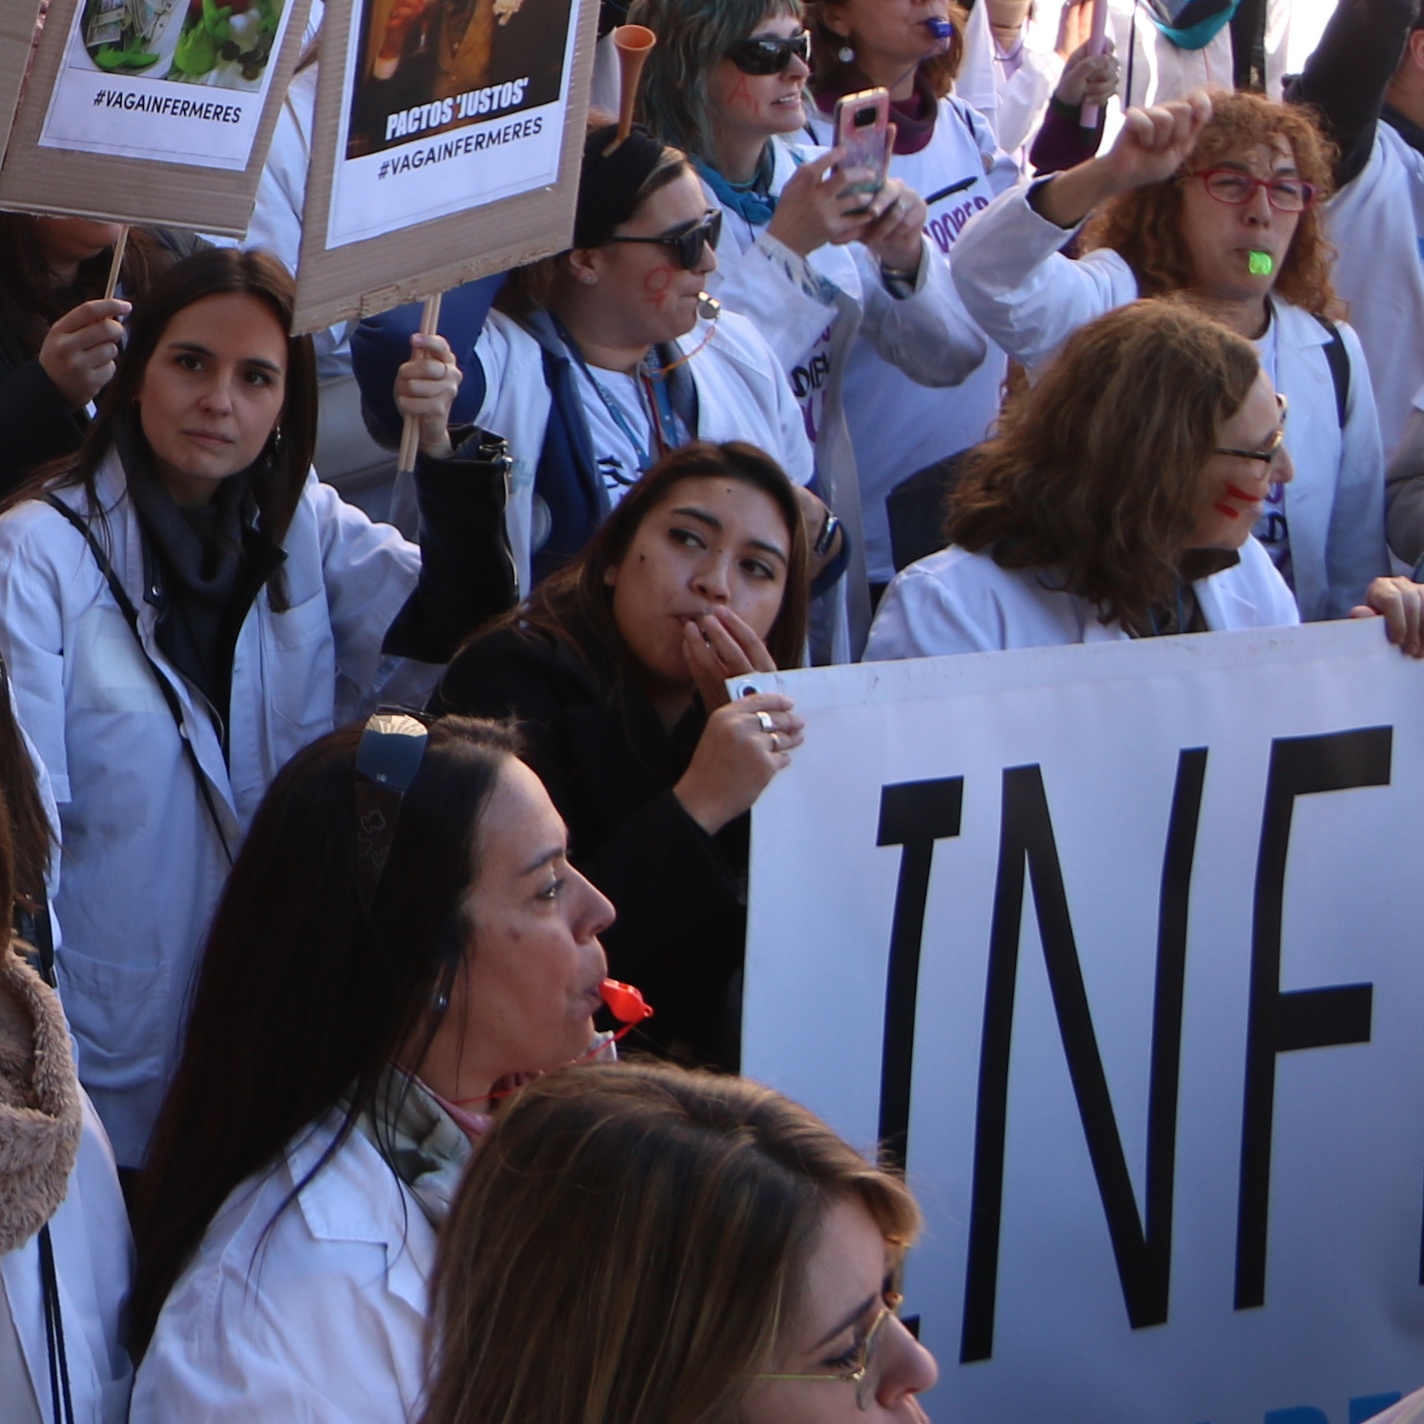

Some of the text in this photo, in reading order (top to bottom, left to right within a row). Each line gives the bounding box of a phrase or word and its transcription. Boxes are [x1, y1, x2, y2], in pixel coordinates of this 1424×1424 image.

[92, 88, 243, 125] #VAGAINFERMERES
[383, 104, 454, 142] PACTOS
[376, 116, 544, 181] #VAGAINFERMERES
